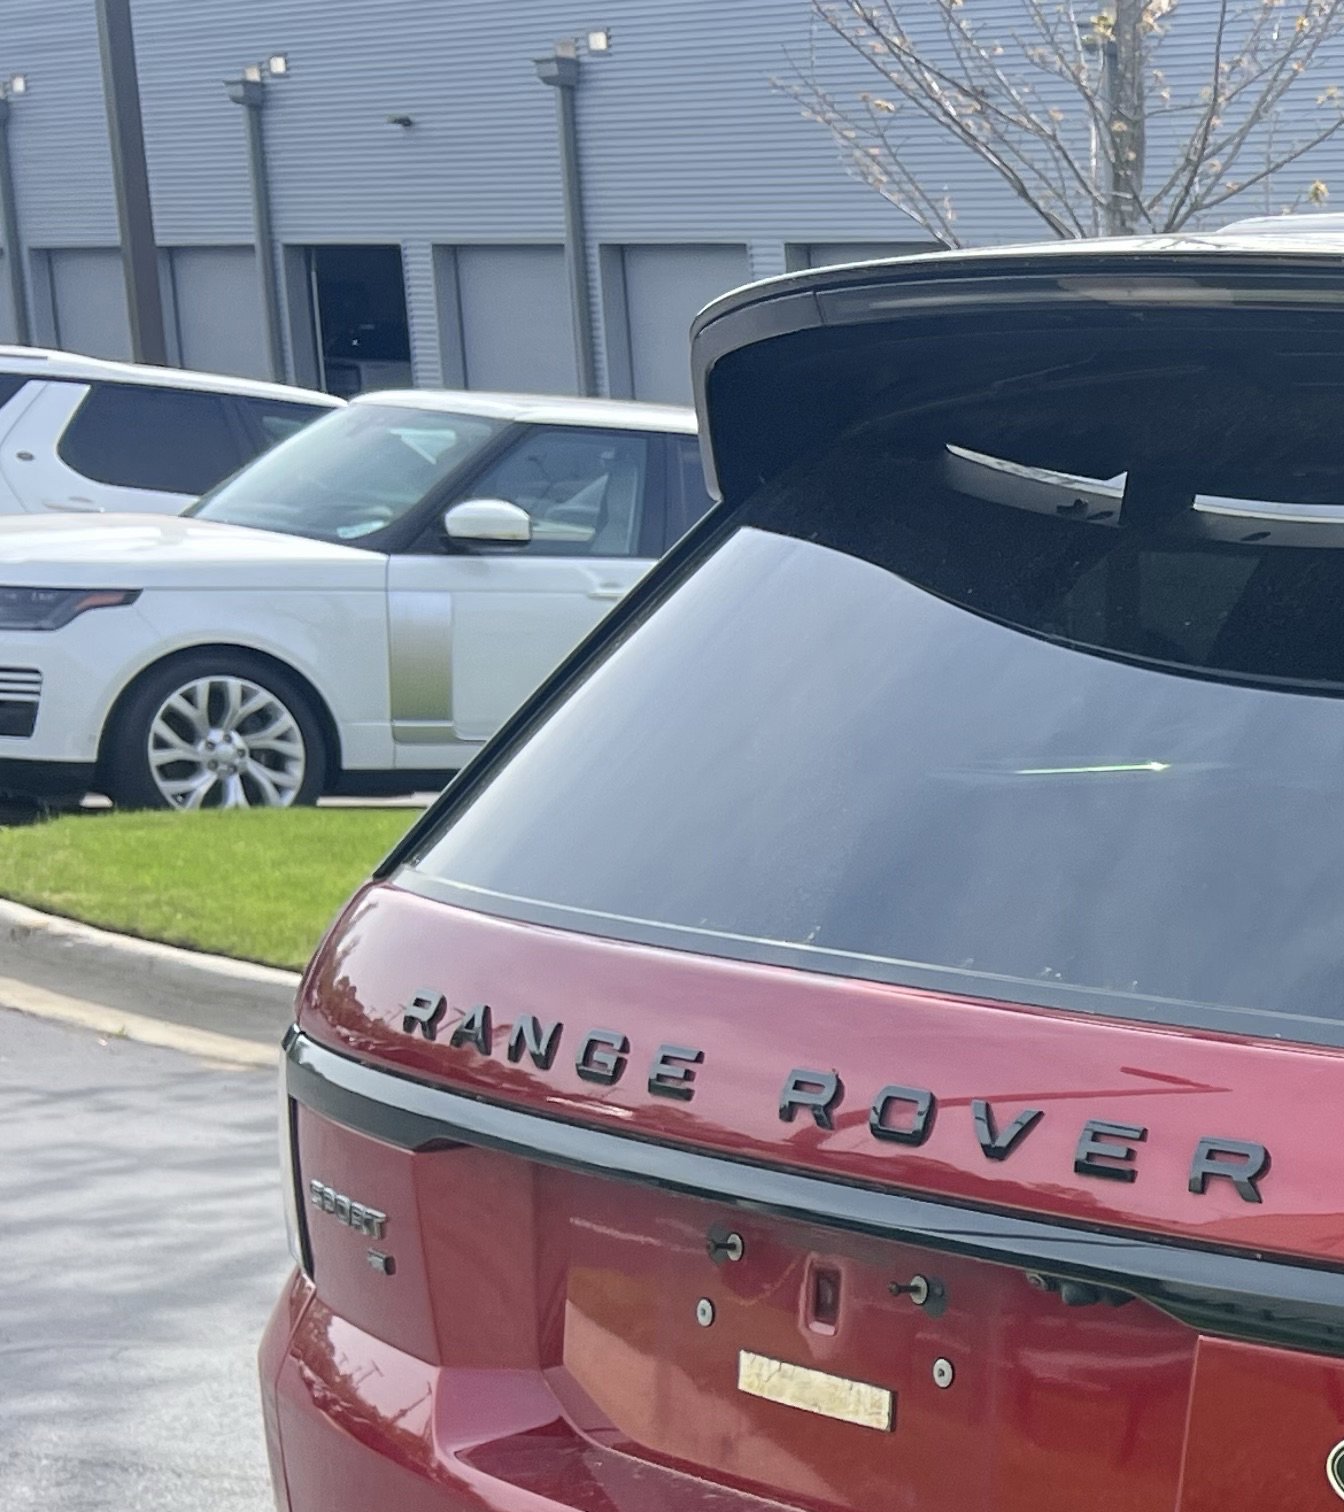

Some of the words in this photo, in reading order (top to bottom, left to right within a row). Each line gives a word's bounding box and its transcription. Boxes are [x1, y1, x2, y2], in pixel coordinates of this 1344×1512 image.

[402, 988, 704, 1101] RANGE
[777, 1068, 1271, 1203] ROVER
[310, 1179, 387, 1240] SPORT
